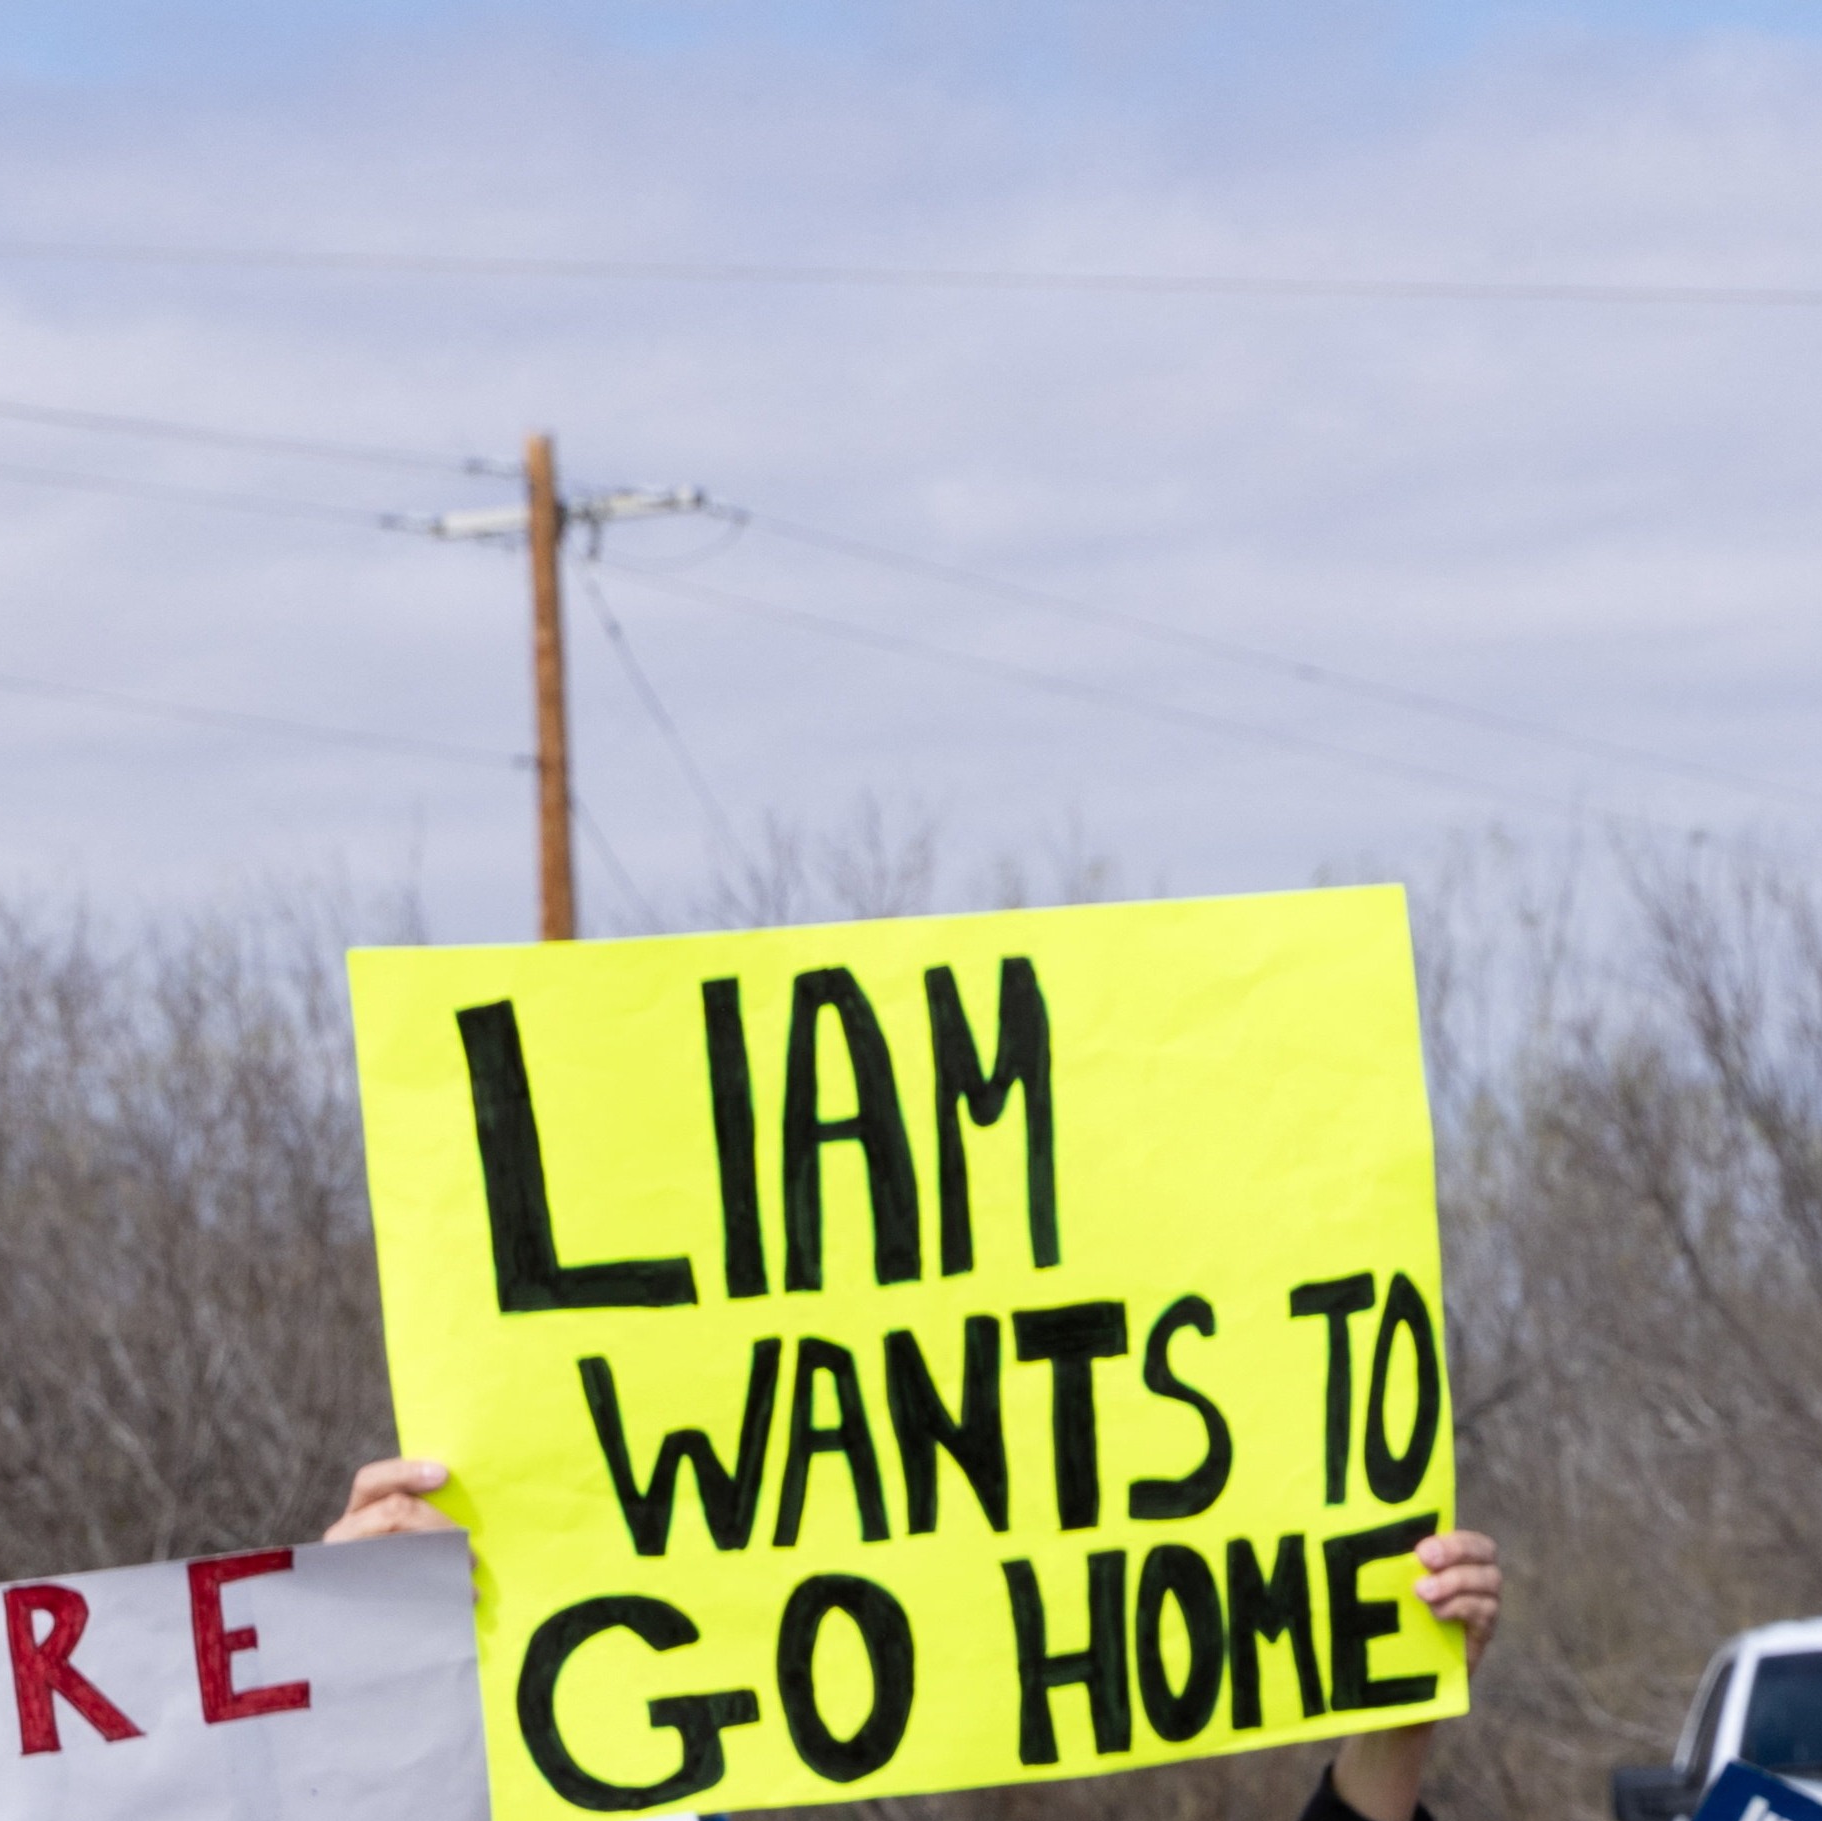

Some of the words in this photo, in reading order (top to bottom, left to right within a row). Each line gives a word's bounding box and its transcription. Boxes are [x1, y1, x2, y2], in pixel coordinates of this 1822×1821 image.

[456, 956, 1060, 1313] LIAM
[578, 1294, 1234, 1557] WANTS
[1289, 1271, 1440, 1506] TO
[516, 1573, 915, 1812] GO
[1000, 1512, 1440, 1766] HOME
